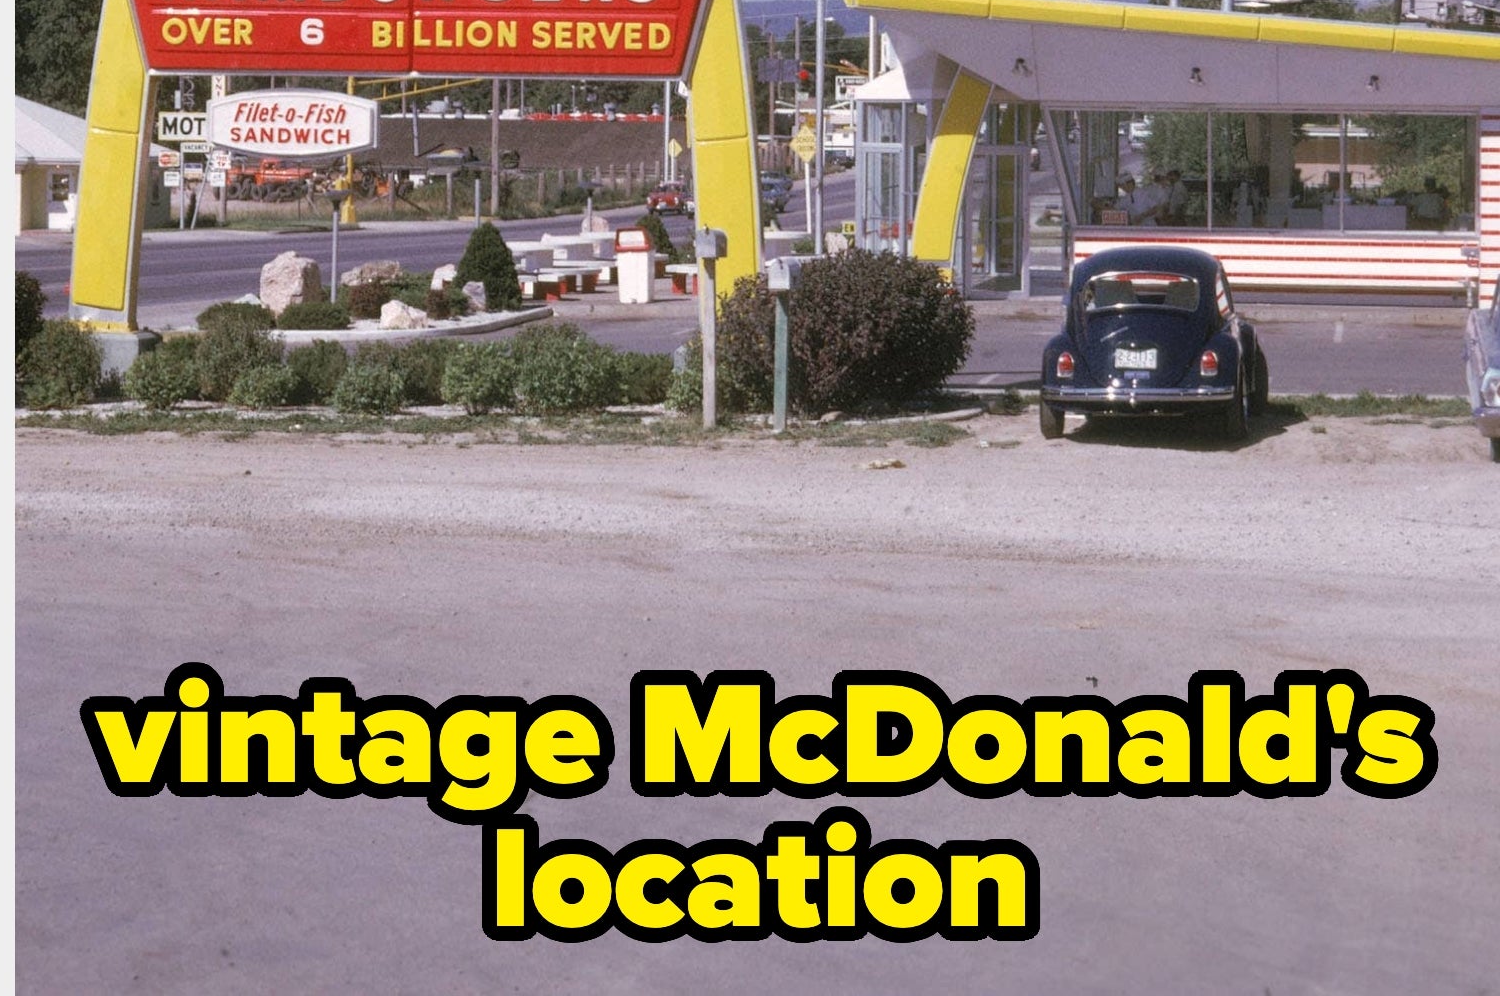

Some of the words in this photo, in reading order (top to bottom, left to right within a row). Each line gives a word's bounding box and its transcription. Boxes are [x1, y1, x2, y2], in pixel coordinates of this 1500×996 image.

[162, 17, 253, 46] OVER
[299, 18, 324, 46] 6
[371, 20, 518, 49] BILLION
[531, 22, 672, 50] SERVED
[234, 102, 348, 123] Filet-o-Fish
[230, 128, 350, 144] SANDWICH
